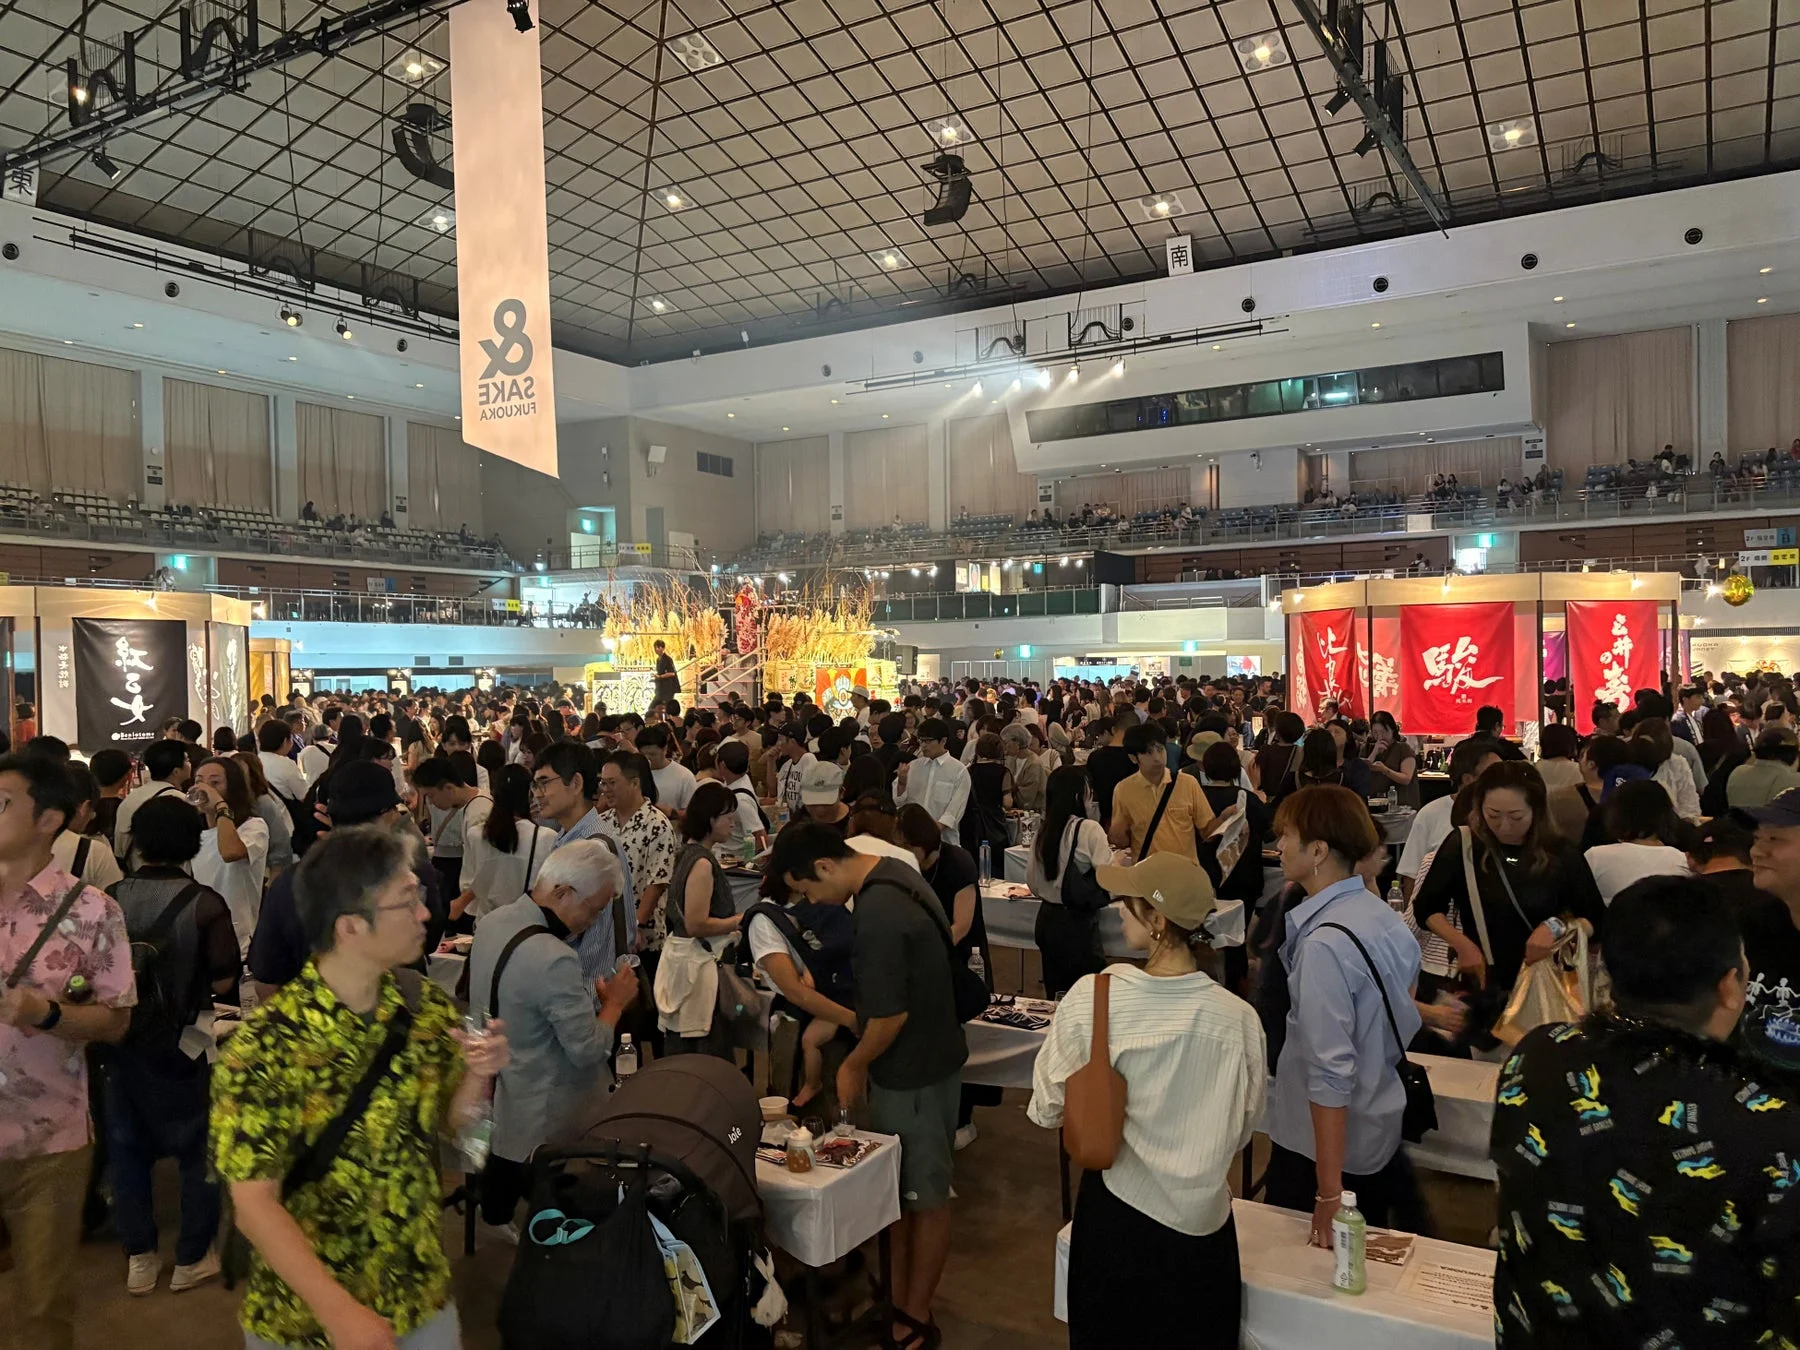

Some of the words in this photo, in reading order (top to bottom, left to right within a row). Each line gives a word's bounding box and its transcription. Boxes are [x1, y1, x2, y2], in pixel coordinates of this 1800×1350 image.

[9, 167, 34, 196] 東
[1170, 245, 1188, 269] 南
[1422, 636, 1505, 694] 駿
[110, 636, 154, 726] 紅乙女
[727, 1126, 743, 1145] Joie
